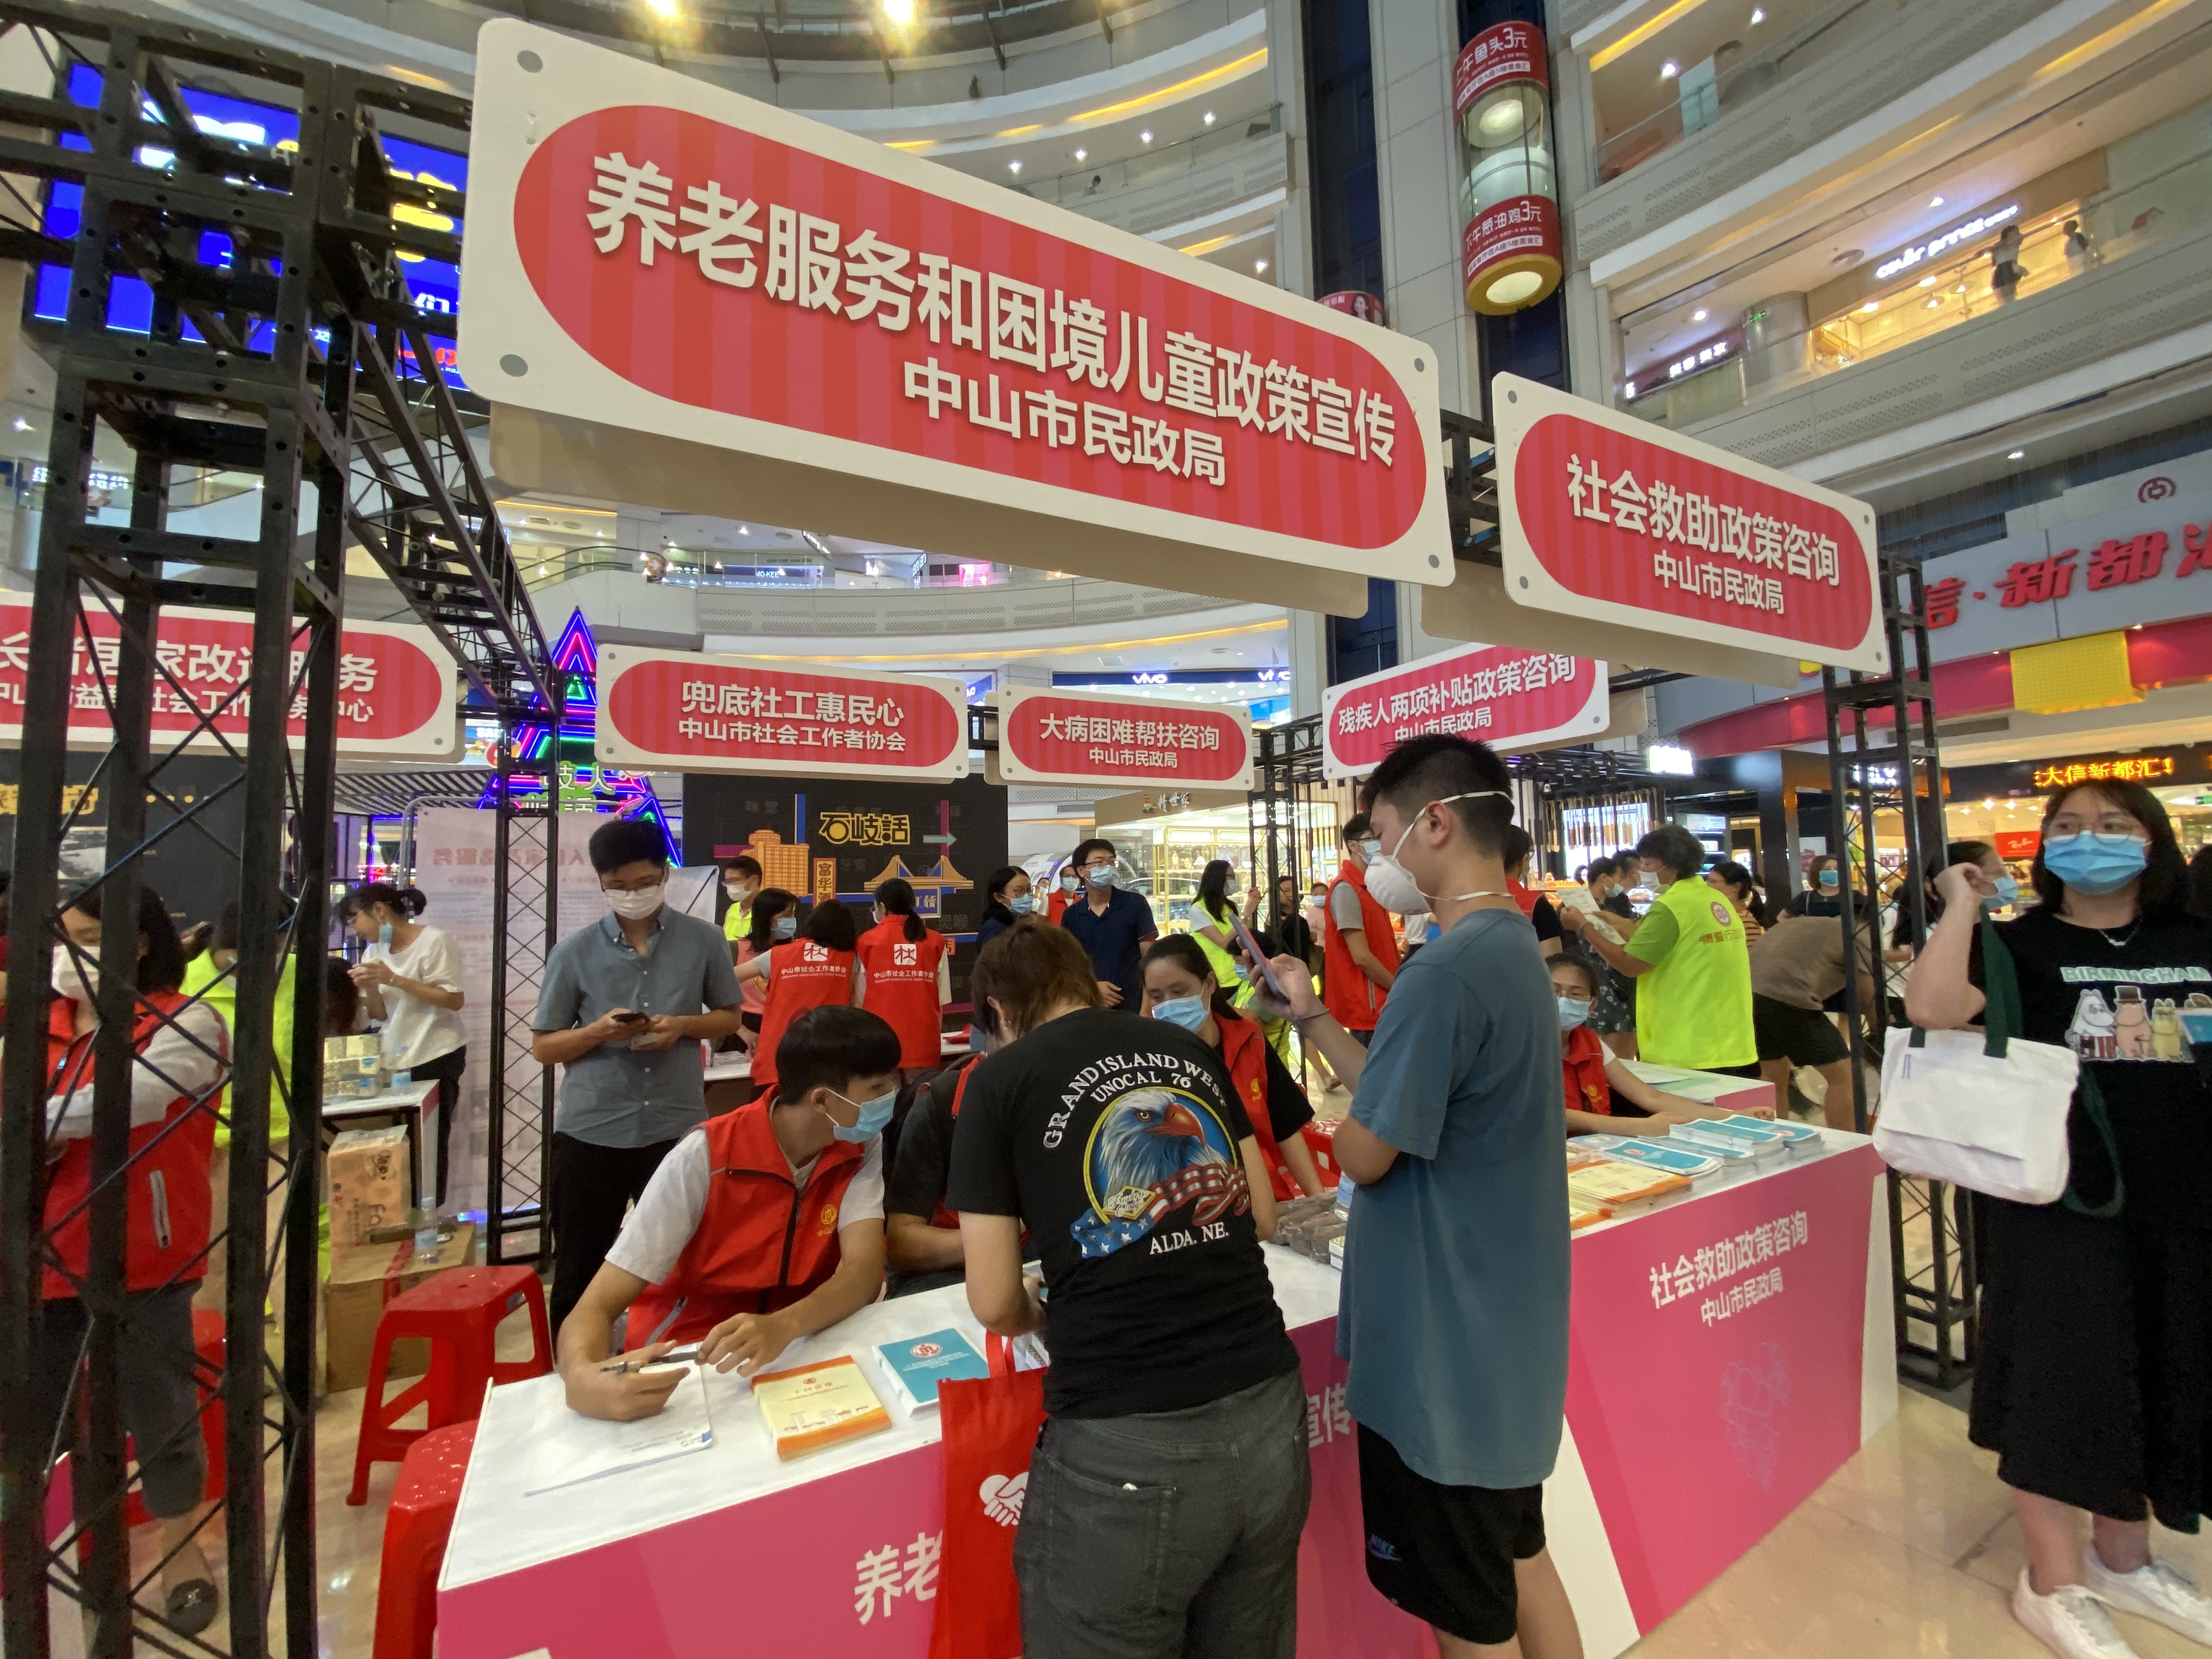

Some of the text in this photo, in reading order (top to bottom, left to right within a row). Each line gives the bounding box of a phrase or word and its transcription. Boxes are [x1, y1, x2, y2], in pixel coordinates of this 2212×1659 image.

[586, 151, 1396, 469] 养老服务和困境儿童政策宣传
[904, 357, 1227, 487] 中山市民政局
[1567, 454, 1839, 586] 社会救助政策咨询
[1654, 550, 1784, 614] 中山市民政局
[1132, 673, 1167, 684] vivo
[1258, 669, 1290, 681] vio
[1338, 652, 1576, 736] 残疾人两项补贴政策咨询
[681, 680, 905, 727] 兜底社工惠民心
[679, 718, 906, 752] 中山市社会工作者协会
[1040, 713, 1220, 751] 大病困难帮扶咨询
[1089, 747, 1177, 769] 中山市民政局
[819, 811, 910, 846] 石岐話
[781, 965, 846, 975] 中山市社会工作者协会
[2060, 966, 2212, 984] BIRMINGHAM
[1043, 1066, 1099, 1148] GRAND
[1098, 1053, 1178, 1075] ISLAND
[1090, 1071, 1192, 1103] UNOCAL 76
[1649, 1210, 1808, 1309] 社会救助政策咨询
[1701, 1267, 1784, 1328] 中山市民政局
